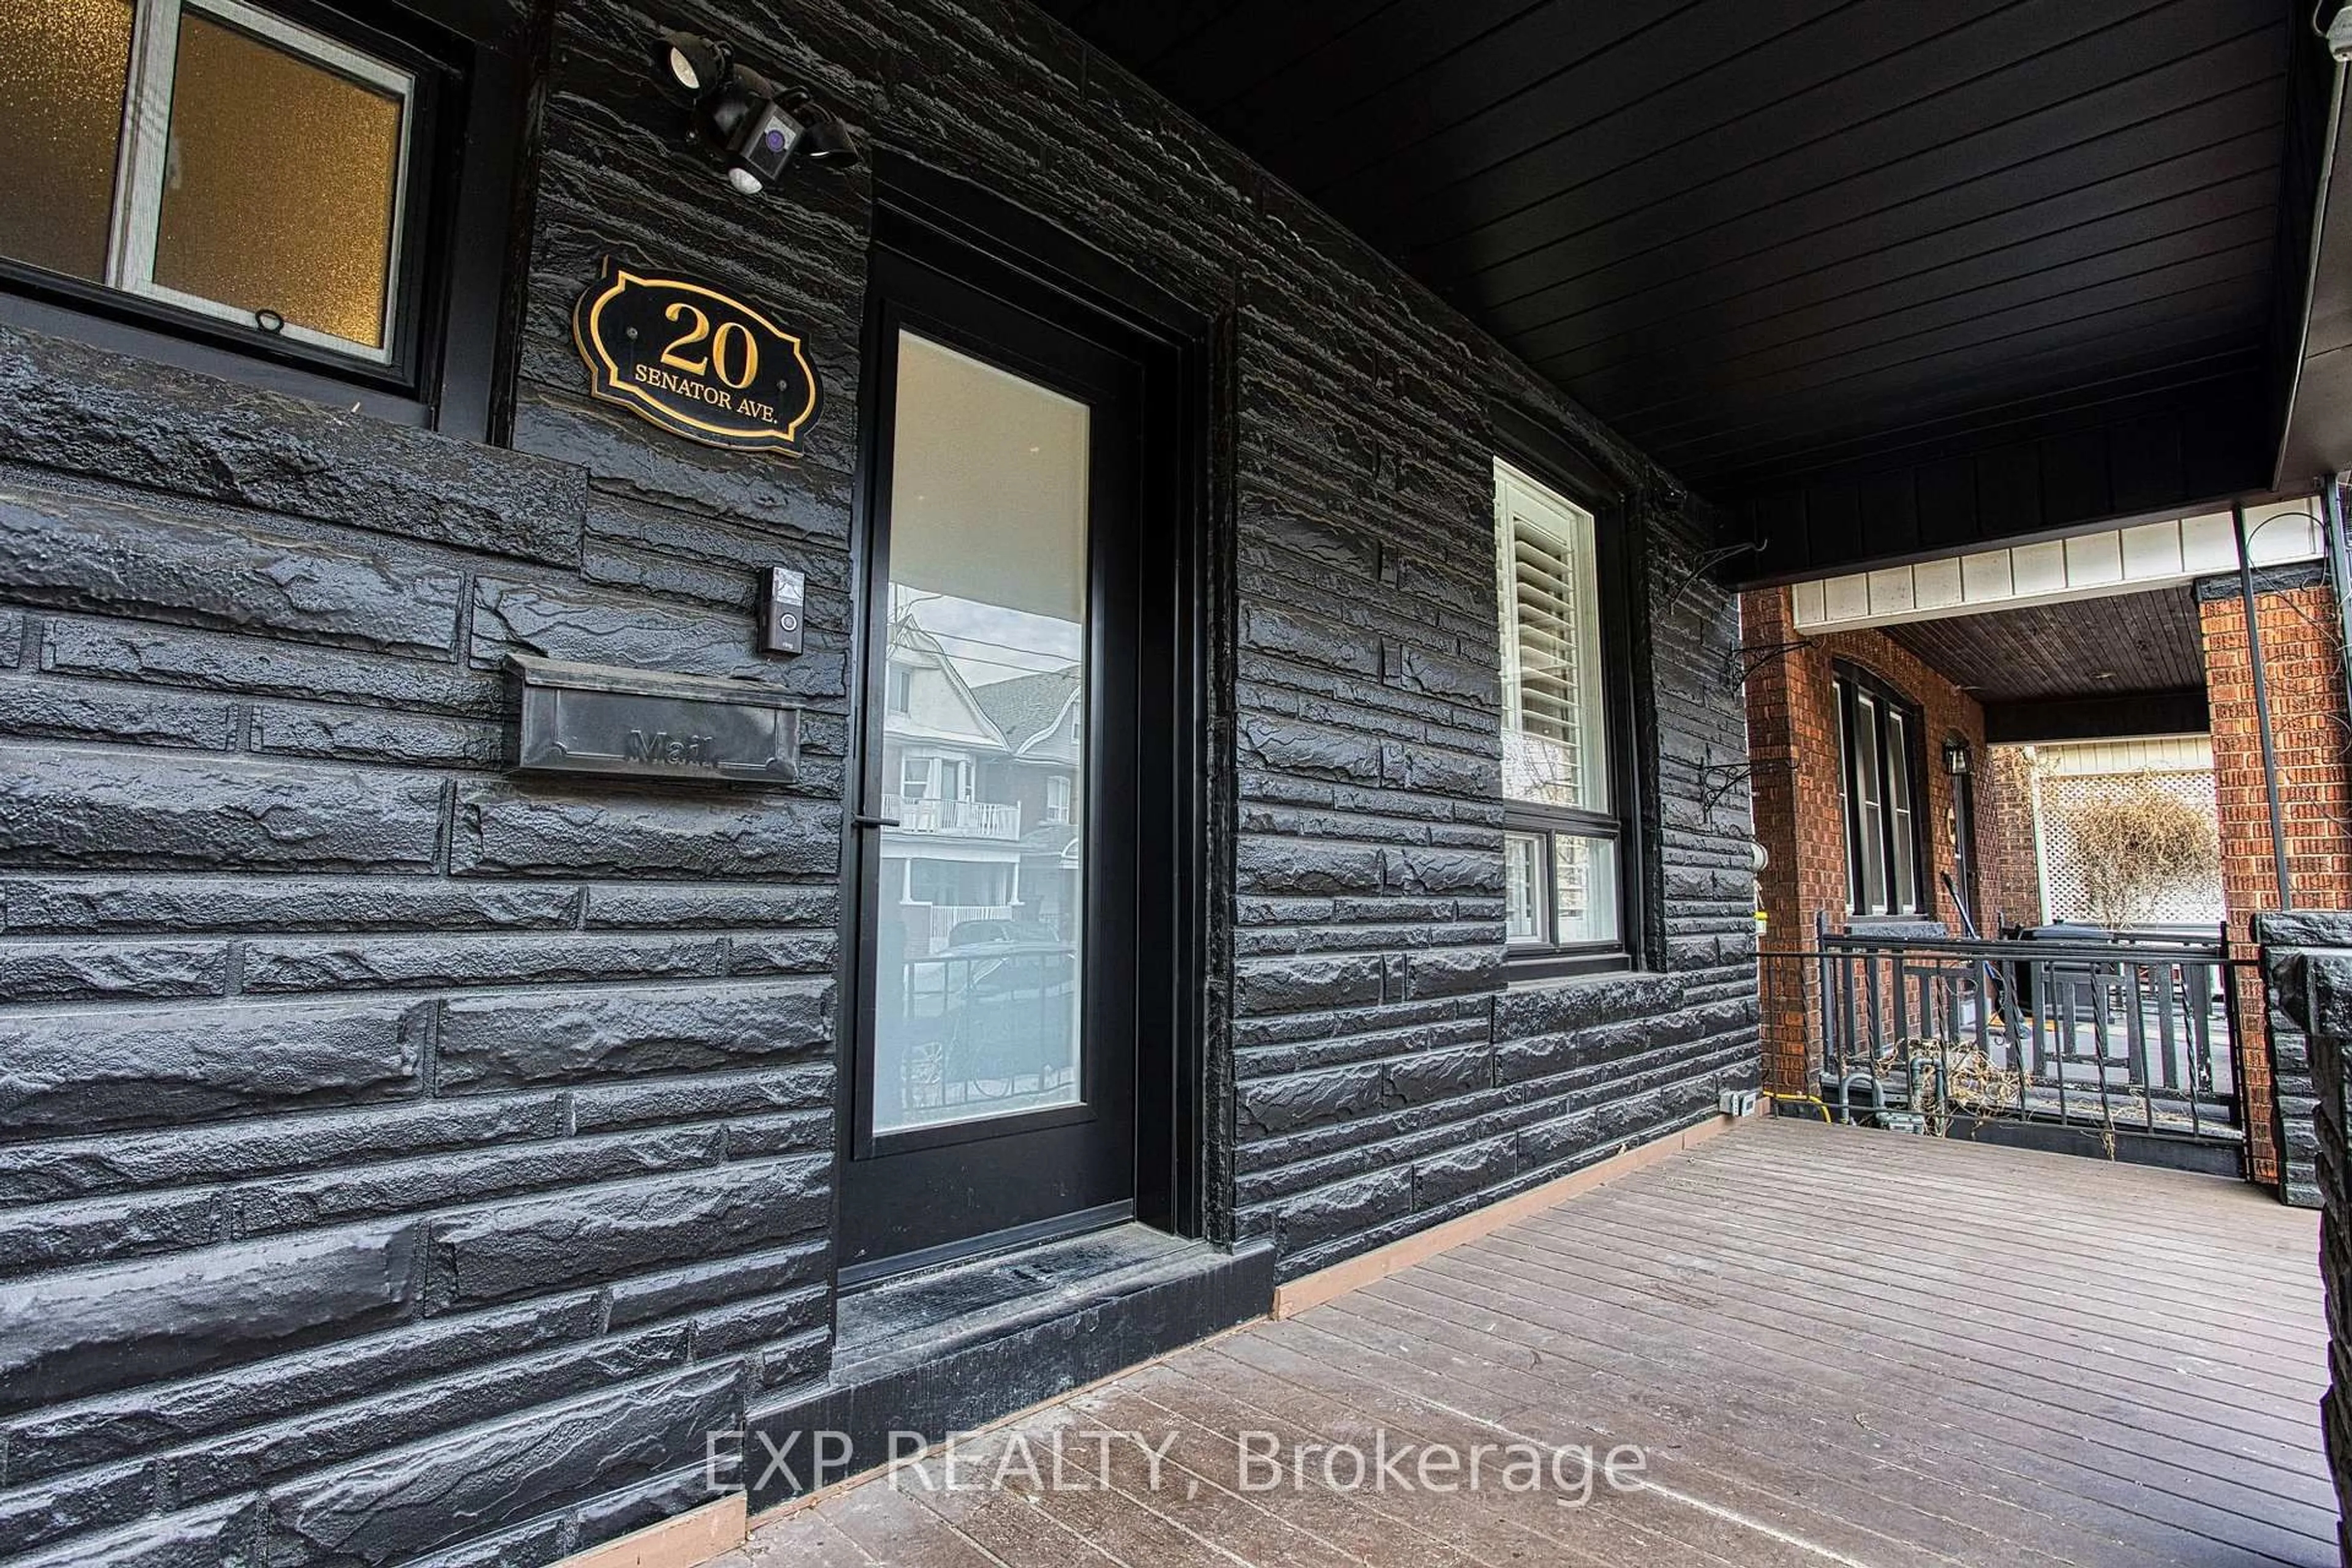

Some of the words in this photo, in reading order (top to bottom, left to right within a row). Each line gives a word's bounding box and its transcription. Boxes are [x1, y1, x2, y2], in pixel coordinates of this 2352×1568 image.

[661, 303, 758, 390] 20
[635, 364, 732, 410] SENATOR
[737, 398, 778, 424] AVE.
